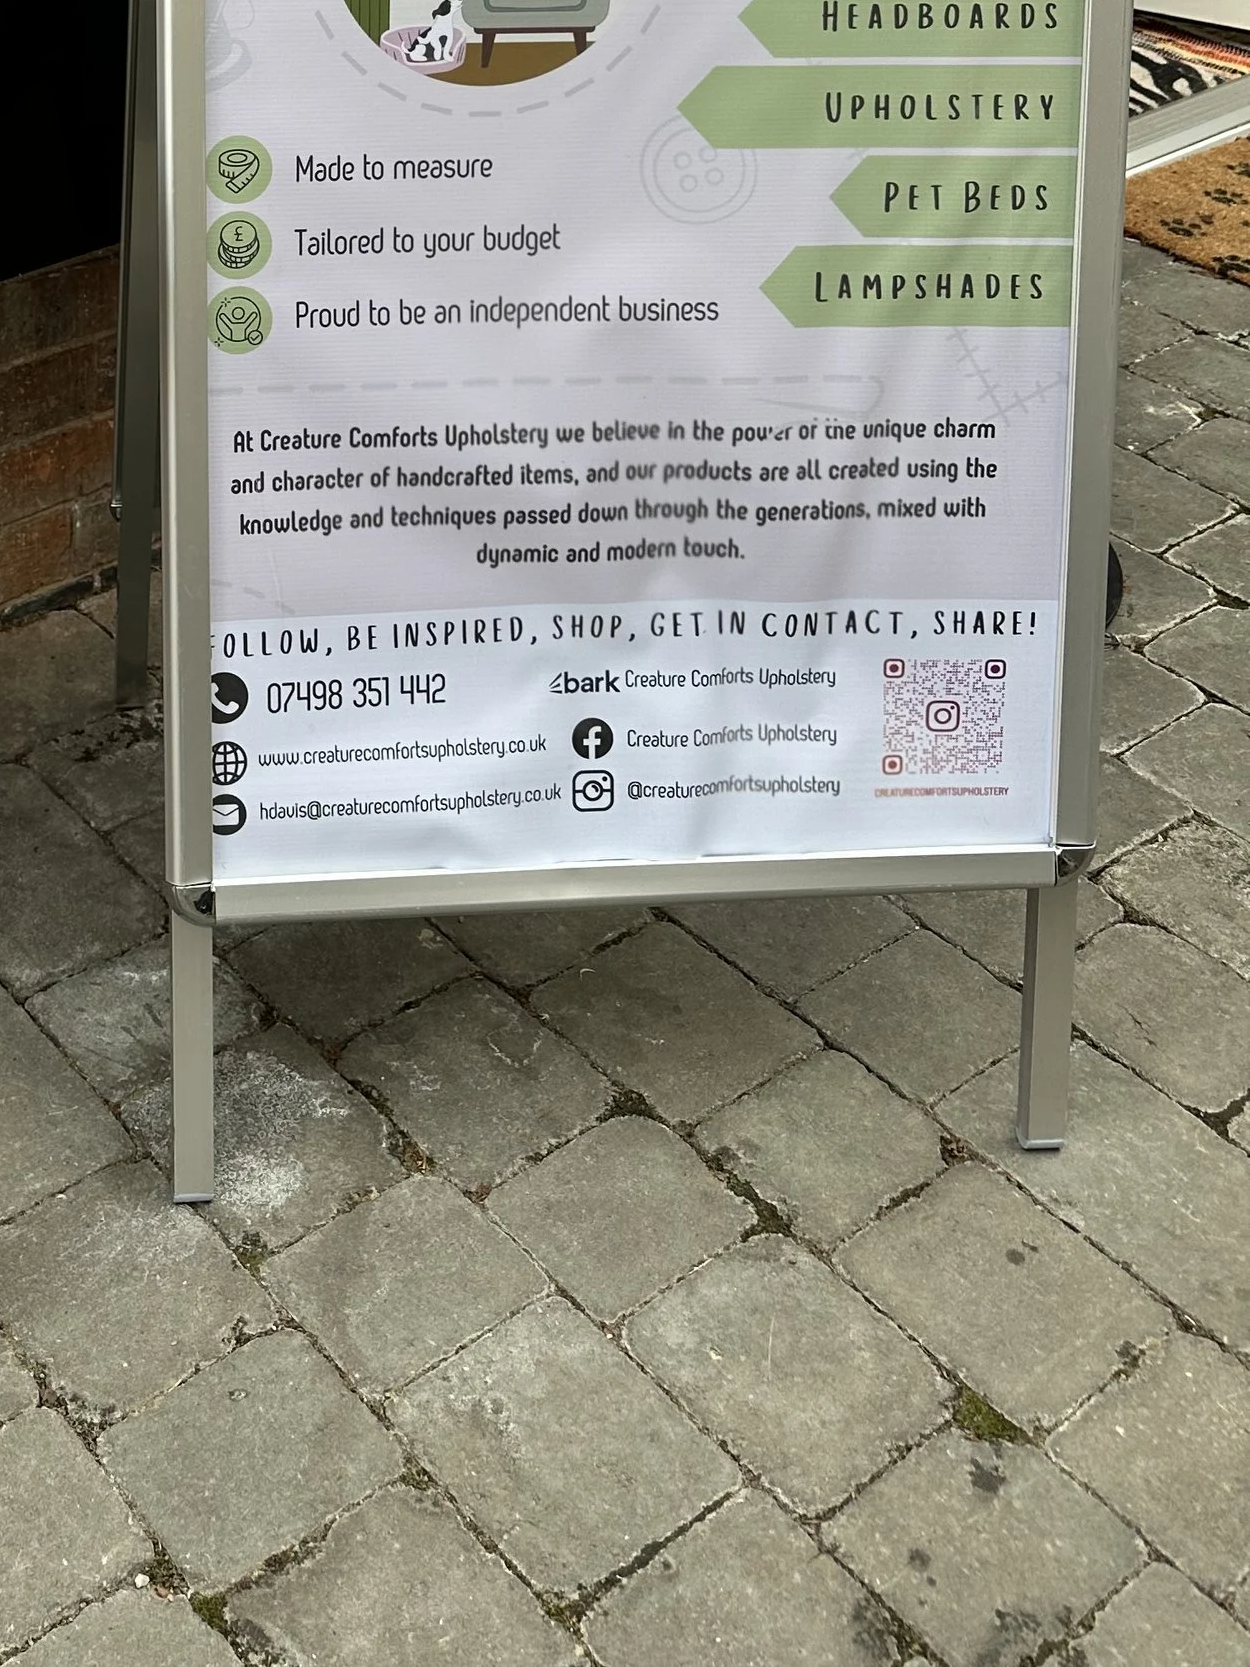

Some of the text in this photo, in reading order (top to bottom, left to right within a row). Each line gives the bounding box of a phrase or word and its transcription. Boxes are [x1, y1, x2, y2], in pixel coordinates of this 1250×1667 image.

[822, 0, 1059, 33] HEADBOARDS
[825, 92, 1055, 123] UPHOLSTERY
[295, 155, 493, 183] Made to measure
[883, 181, 1049, 213] PET BEDS
[294, 223, 562, 259] Tailored to your budget
[814, 271, 1044, 303] LAMPSHADES
[295, 295, 719, 329] Proud to be an independent business
[233, 429, 254, 454] At
[260, 427, 342, 452] Creature
[349, 425, 438, 449] Comforts
[445, 422, 548, 451] Upholstery
[556, 427, 585, 444] we
[592, 419, 660, 442] believe
[667, 420, 685, 440] in
[693, 419, 725, 442] the
[863, 418, 927, 443] unique
[933, 416, 996, 439] charm
[230, 456, 998, 495] and character of handcrafted items, and our products are all created using the
[239, 496, 986, 536] knowledge and techniques passed down through the generations, mixed with
[476, 536, 746, 569] dynamic and modern touch.
[347, 625, 379, 652] BE
[392, 616, 538, 648] INSPIRED,
[551, 613, 637, 642] SHOP,
[650, 611, 705, 637] GET
[718, 609, 746, 636] IN
[761, 609, 918, 640] CONTACT,
[933, 610, 1039, 637] SHARE!
[266, 673, 447, 715] 07498 351 442
[564, 667, 837, 694] bark Creature Comforts Upholstery
[257, 733, 547, 767] www.creaturecomfortsupholstery.co.uk
[627, 723, 838, 749] Creature Comforts Upholstery
[259, 782, 562, 821] hdavis@creaturecomfortsupholstery.co.uk
[627, 777, 841, 801] @creaturecomfortsupholstery
[874, 786, 1009, 798] CREATURECOMFORTSUPHOLSTERY
